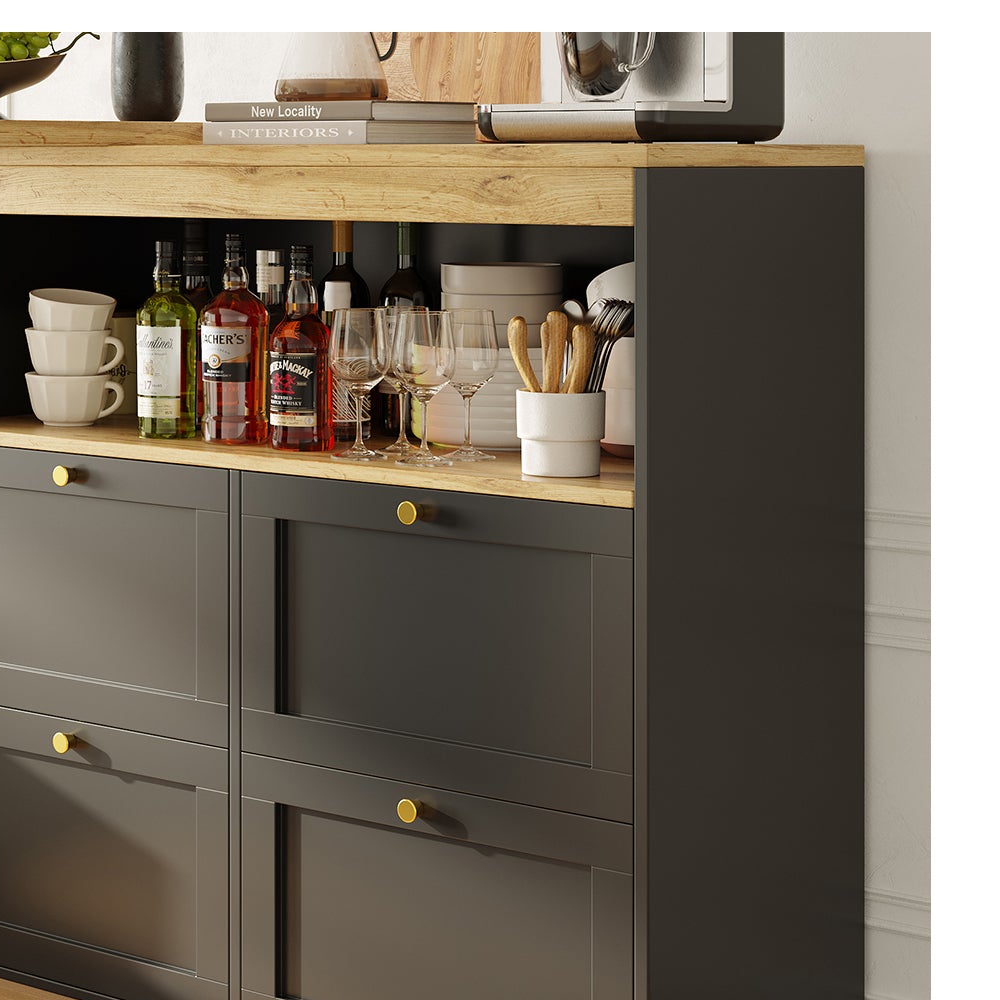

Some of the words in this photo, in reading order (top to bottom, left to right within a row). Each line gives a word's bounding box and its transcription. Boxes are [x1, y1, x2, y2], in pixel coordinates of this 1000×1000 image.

[251, 105, 275, 118] New
[278, 104, 322, 119] Locality
[230, 127, 340, 139] INTERIORS
[283, 359, 314, 379] MACKAY
